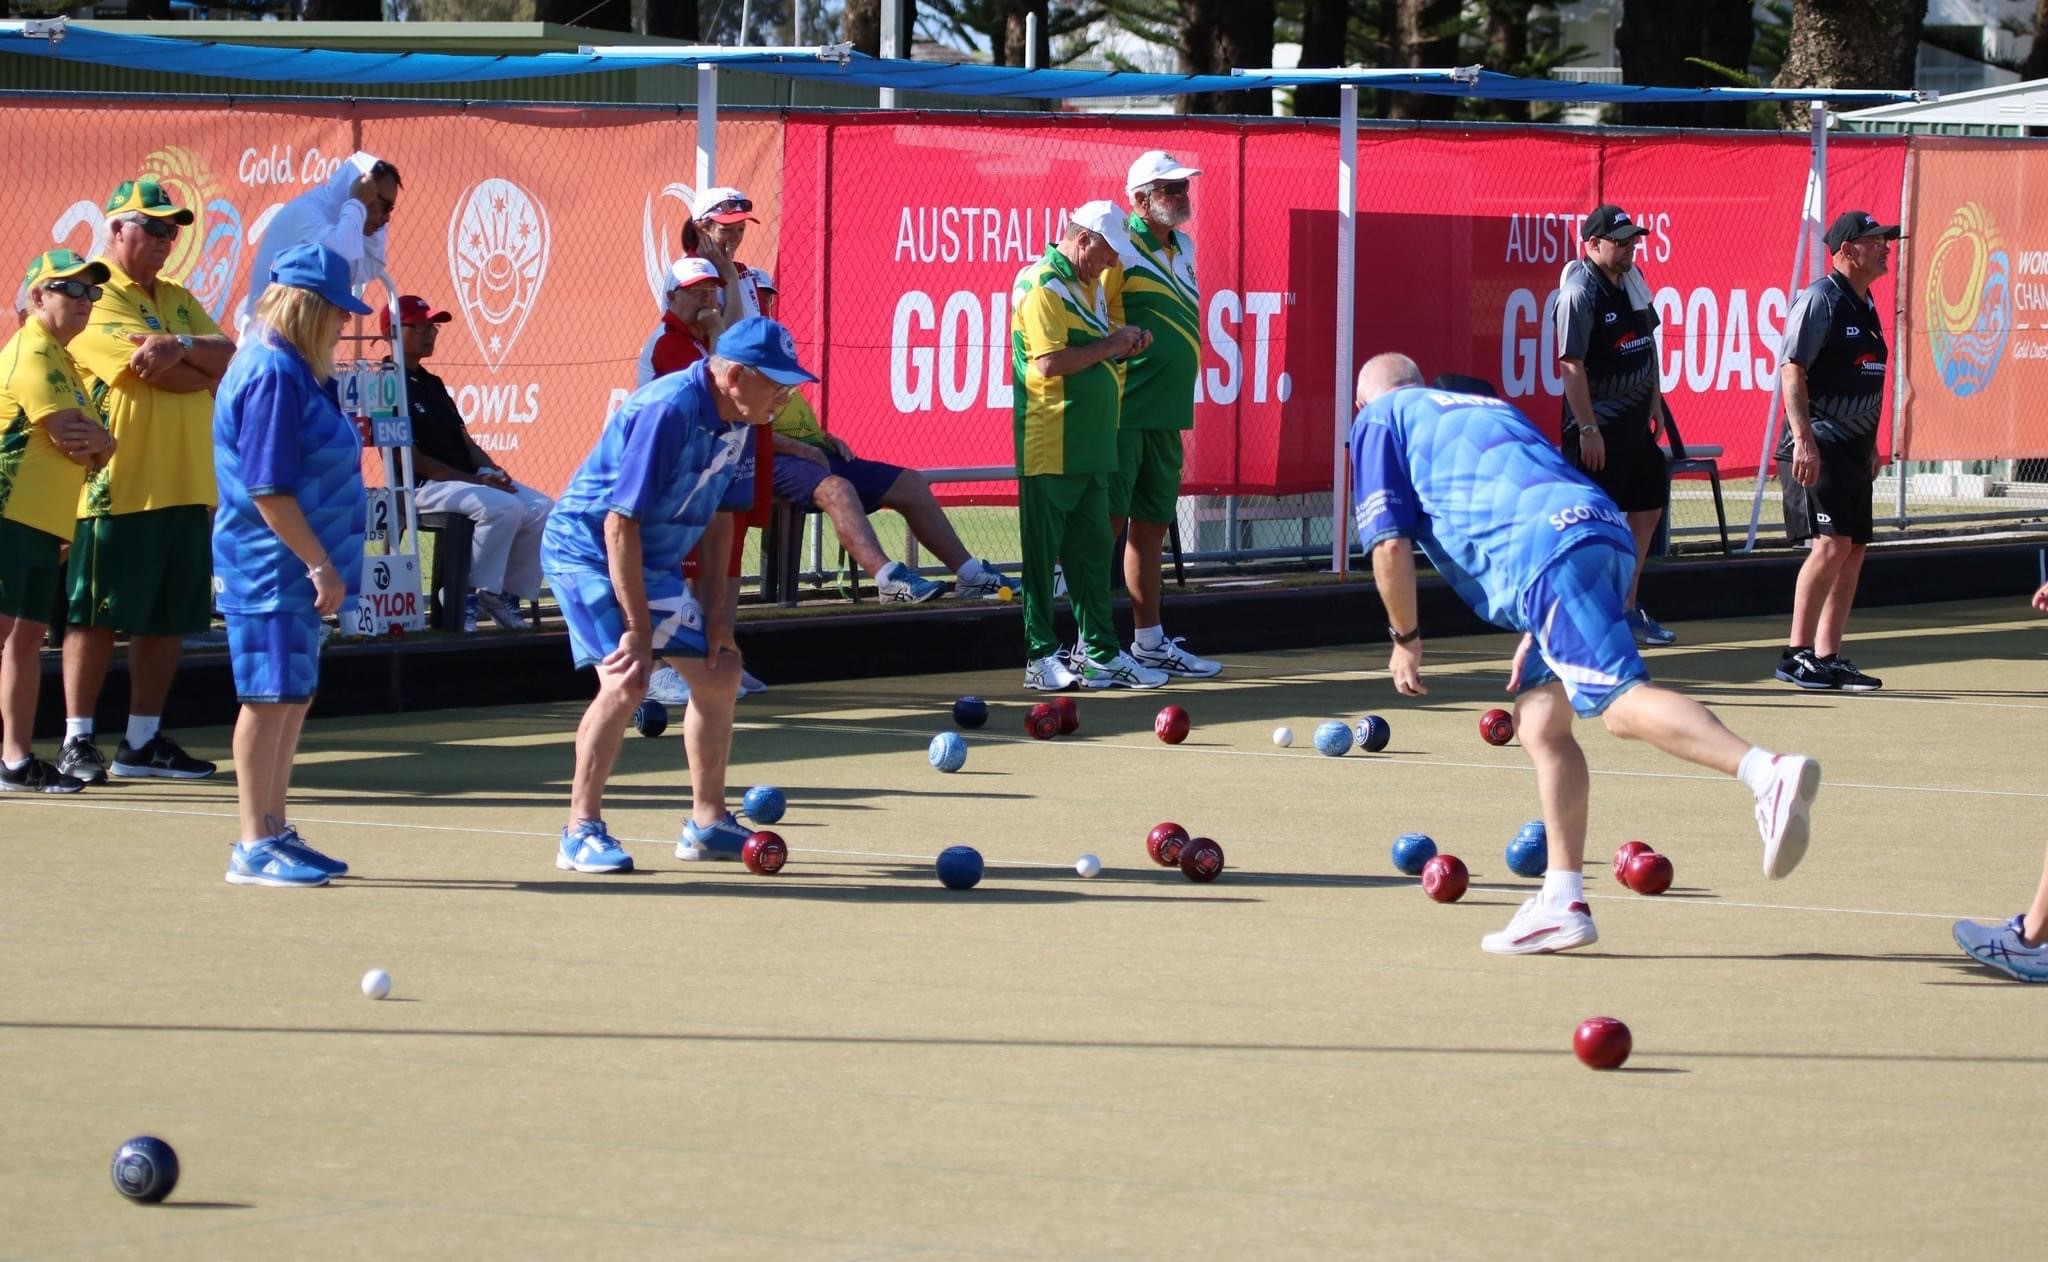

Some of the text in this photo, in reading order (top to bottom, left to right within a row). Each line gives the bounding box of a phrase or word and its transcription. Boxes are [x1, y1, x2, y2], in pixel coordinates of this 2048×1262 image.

[238, 143, 341, 188] Gold Coa
[895, 206, 1082, 264] AUSTRALIA
[2018, 251, 2048, 275] WOR
[890, 289, 1014, 413] GOL
[1194, 288, 1292, 406] ST.
[1652, 286, 1792, 394] COAS
[377, 421, 409, 442] ENG
[470, 432, 519, 452] TRALIA
[375, 500, 388, 532] 2
[355, 605, 374, 633] 26
[364, 591, 417, 618] YLOR
